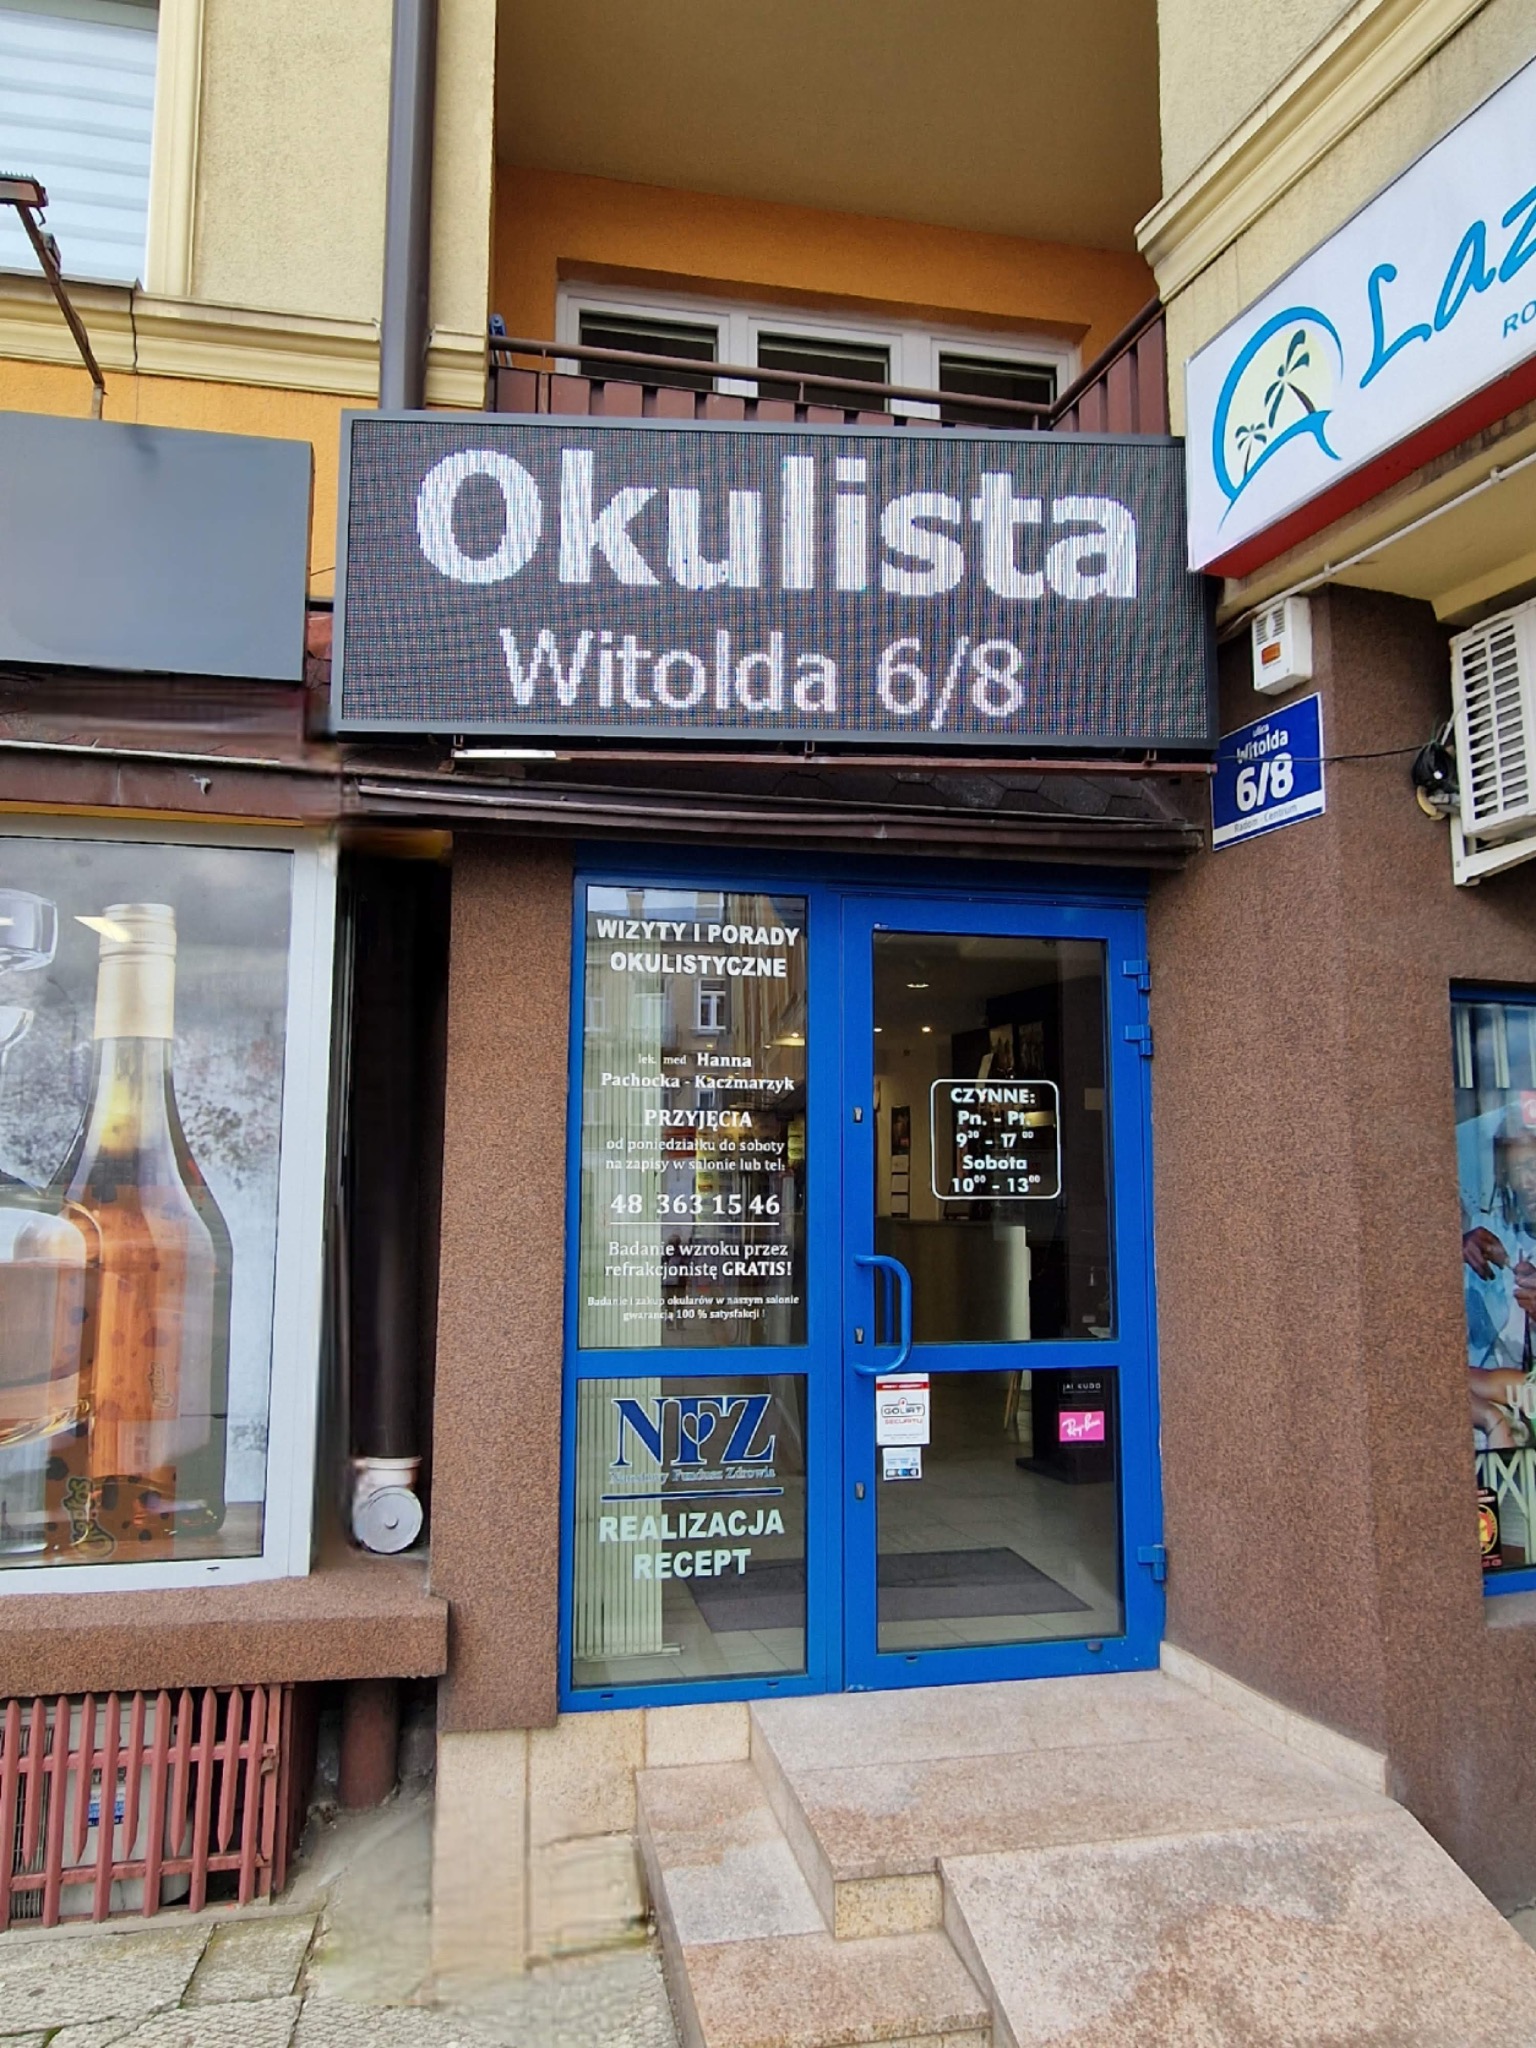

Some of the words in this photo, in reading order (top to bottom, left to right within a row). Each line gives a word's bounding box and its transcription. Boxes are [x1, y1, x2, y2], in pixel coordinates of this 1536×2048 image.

[416, 448, 1138, 602] Okulista
[500, 627, 838, 713] Witolda
[875, 636, 1026, 731] 6/8
[1252, 722, 1270, 738] ulica
[1236, 729, 1289, 764] Witolda
[1236, 752, 1294, 812] 6/8
[597, 918, 687, 941] WIZYTY
[693, 924, 700, 943] I
[707, 924, 800, 946] PORADY
[610, 952, 787, 978] OKULISTYCZNE
[637, 1053, 657, 1065] lek.
[697, 1052, 752, 1068] Hanna
[601, 1073, 681, 1089] Pachocka
[694, 1075, 795, 1094] Kaczmarzyk
[950, 1088, 1036, 1104] CZYNNE:
[644, 1109, 752, 1131] PRZYJĘCIA
[958, 1110, 987, 1126] Pn.
[606, 1139, 623, 1150] od
[627, 1138, 715, 1152] poniedziałku
[719, 1140, 736, 1151] do
[740, 1139, 785, 1153] soboty
[606, 1160, 622, 1170] na
[626, 1159, 669, 1173] zapisy
[673, 1160, 686, 1170] w
[689, 1158, 736, 1171] salonie
[739, 1159, 761, 1171] lub
[962, 1154, 1028, 1170] Sobota
[610, 1194, 643, 1215] 48
[656, 1194, 703, 1215] 363
[712, 1194, 742, 1215] 15
[749, 1194, 781, 1215] 46
[608, 1241, 674, 1256] Badanie
[679, 1241, 739, 1257] wzroku
[744, 1243, 788, 1259] przez
[605, 1262, 717, 1280] refrakcjonistę
[721, 1261, 792, 1277] GRATIS!
[667, 1296, 713, 1307] okularów
[676, 1309, 695, 1320] 100
[610, 1394, 776, 1467] NFZ
[600, 1509, 785, 1542] REALIZACJA
[633, 1548, 751, 1580] RECEPT
